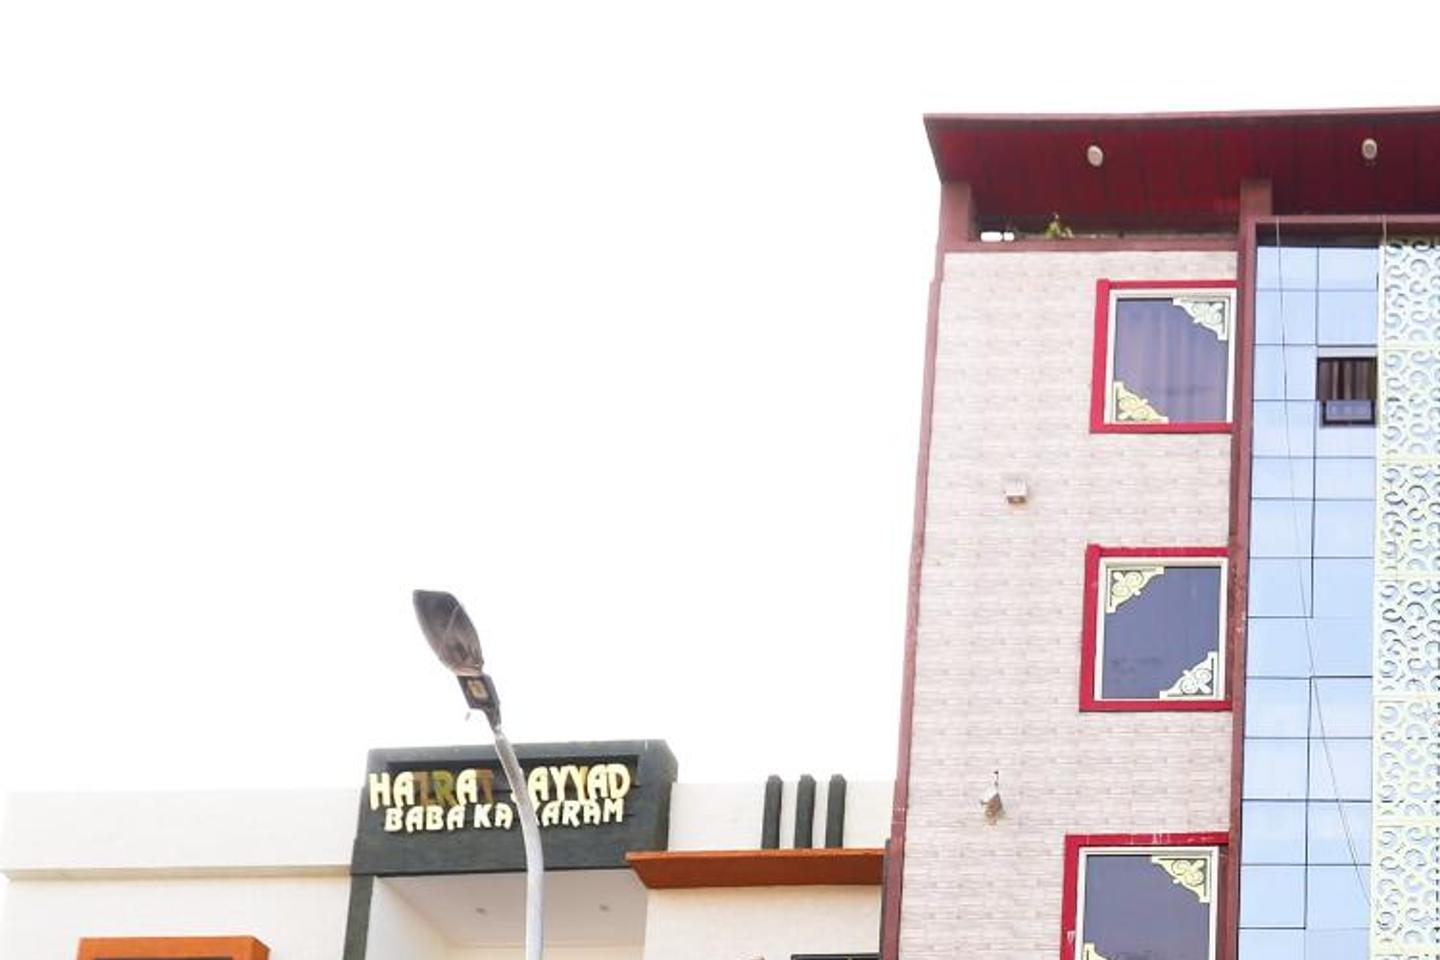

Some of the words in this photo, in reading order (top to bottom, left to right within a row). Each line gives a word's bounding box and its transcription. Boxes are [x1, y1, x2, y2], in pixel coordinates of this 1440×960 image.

[511, 764, 631, 805] AYYAD
[384, 804, 466, 832] BABA
[474, 802, 513, 830] KA
[534, 798, 625, 828] ARAM
